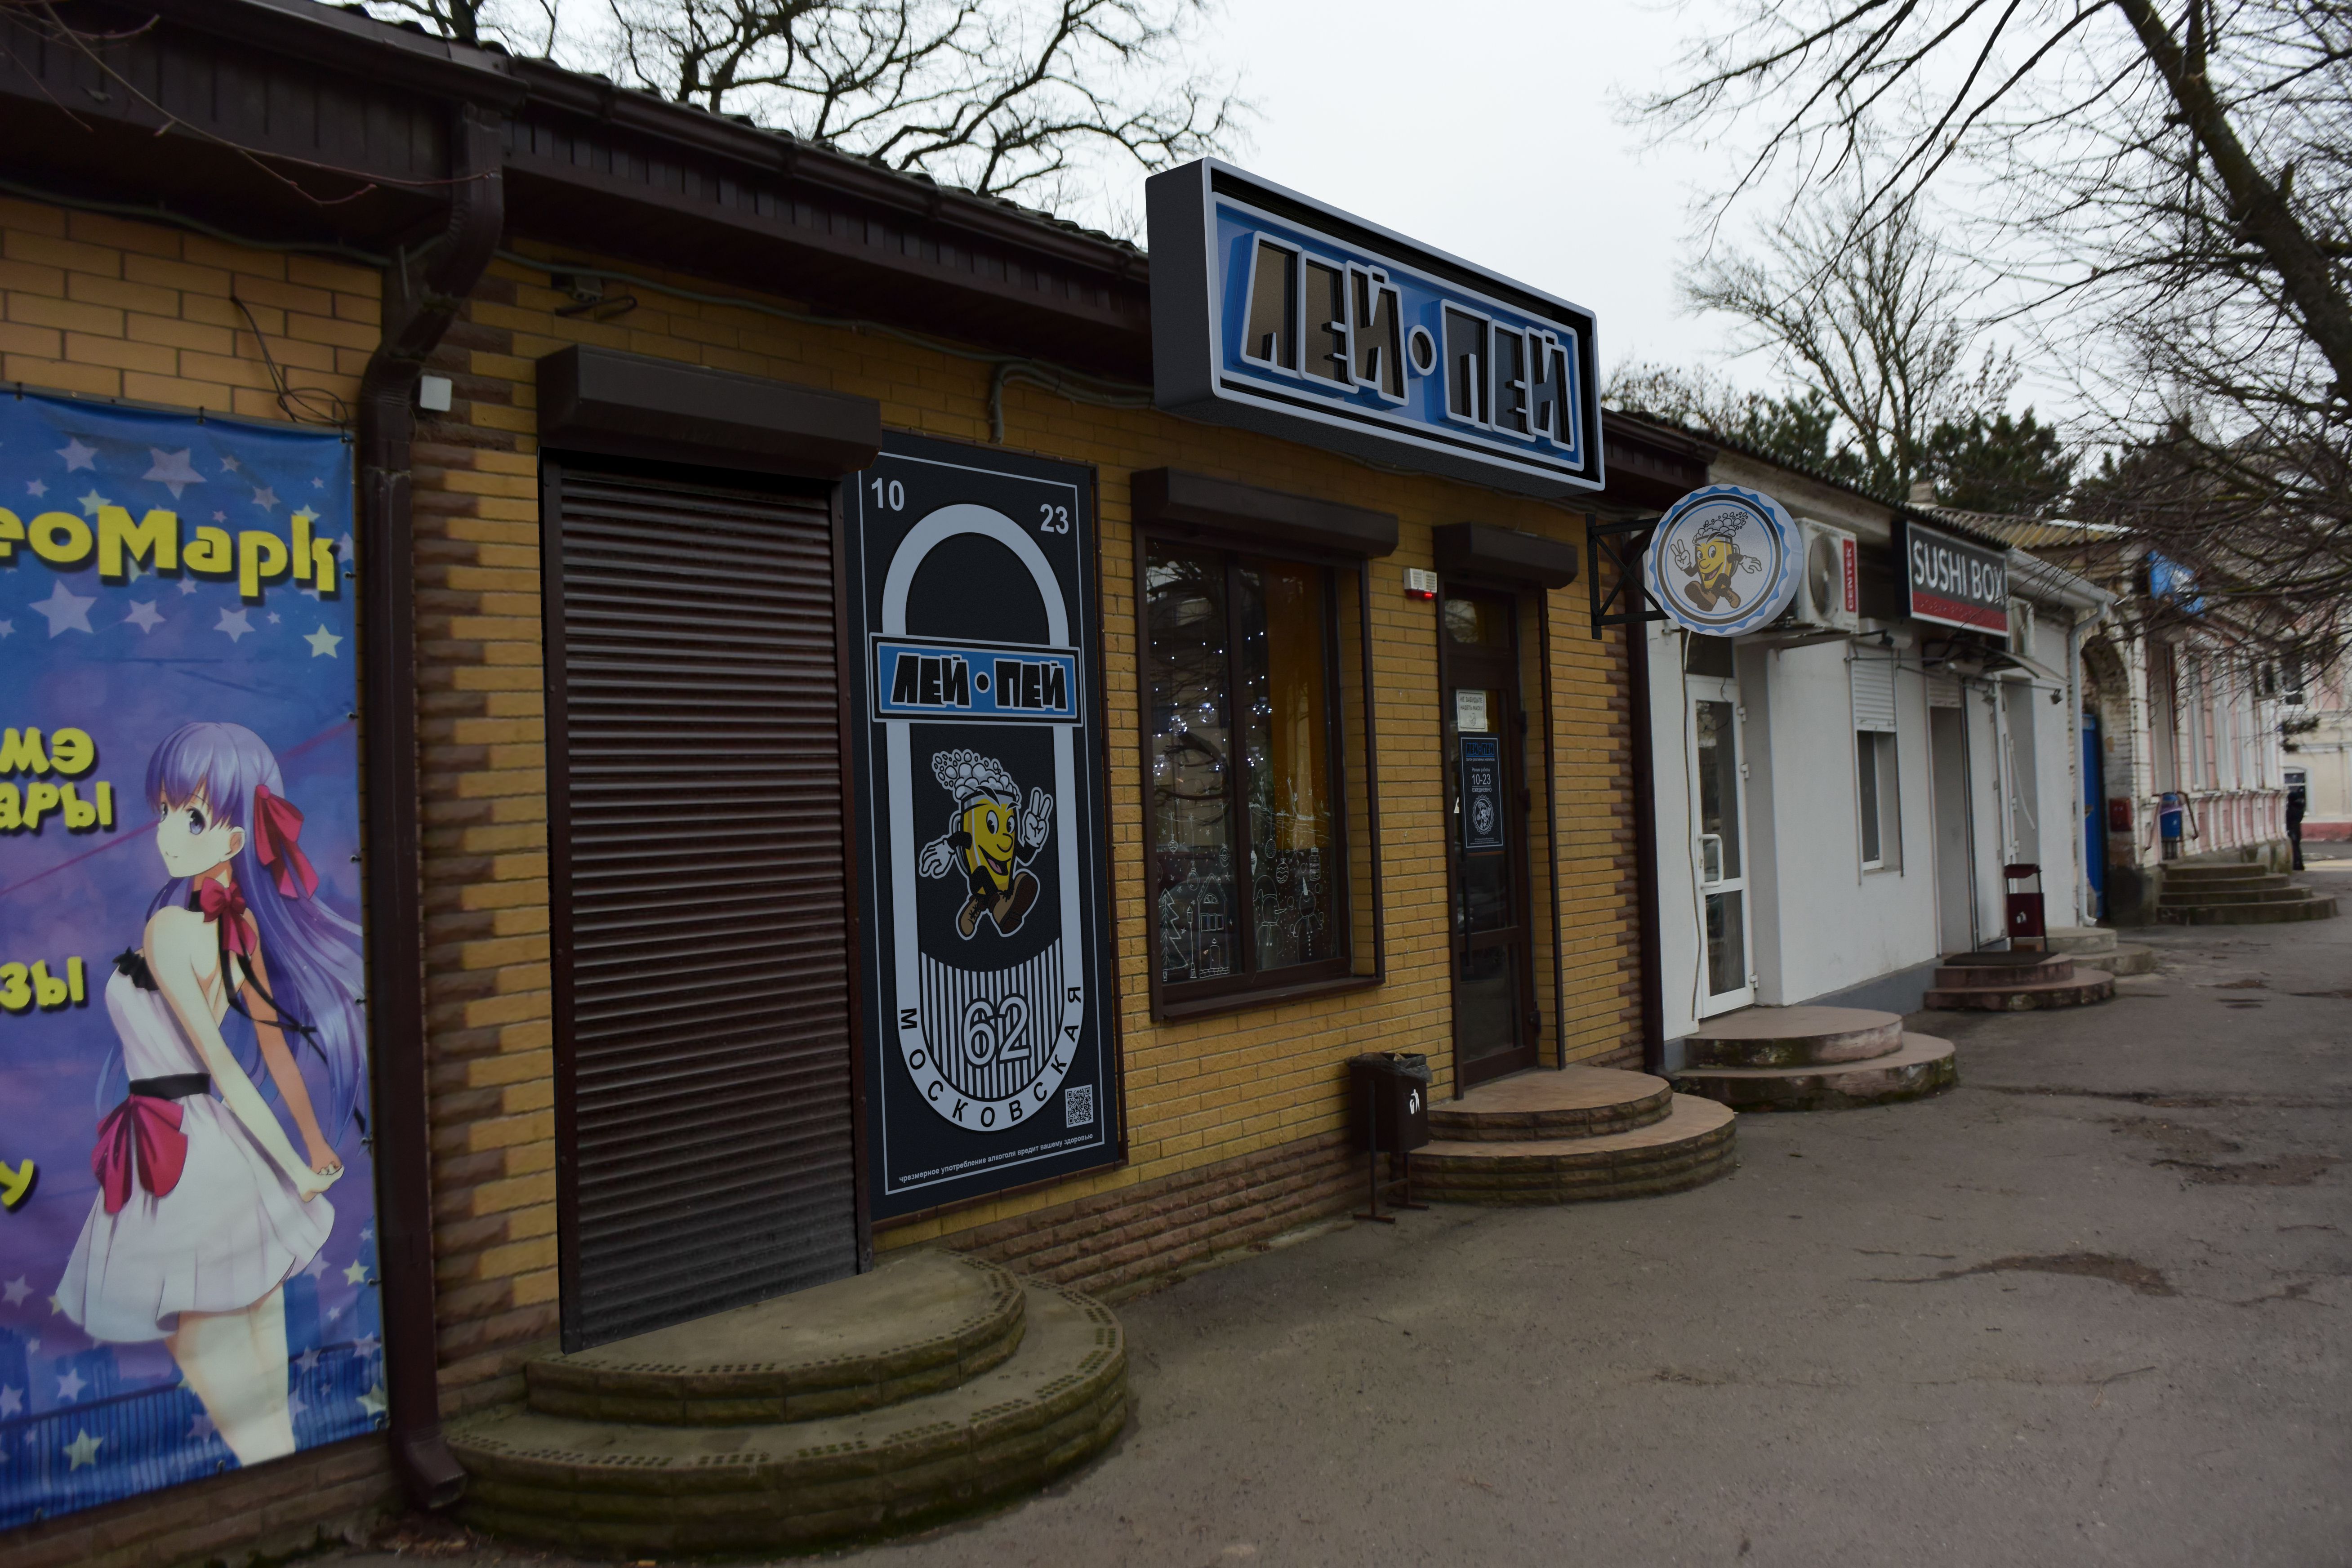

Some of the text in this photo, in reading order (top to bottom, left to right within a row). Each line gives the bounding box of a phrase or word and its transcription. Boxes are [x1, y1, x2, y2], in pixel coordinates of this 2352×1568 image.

[1239, 231, 1575, 451] ЛЕЙ ПЕЙ
[871, 477, 904, 511] 10
[1040, 503, 1069, 534] 23
[1913, 540, 2005, 605] SUSHI BOX
[890, 651, 1069, 712] ЛЕЙ ПЕЙ
[1472, 774, 1491, 785] 10-23
[900, 986, 1082, 1127] МОСКОВСКАЯ
[962, 995, 1031, 1067] 62
[899, 1133, 1093, 1183] чрезмерное употребление алкоголя вредит вашему здоровью
